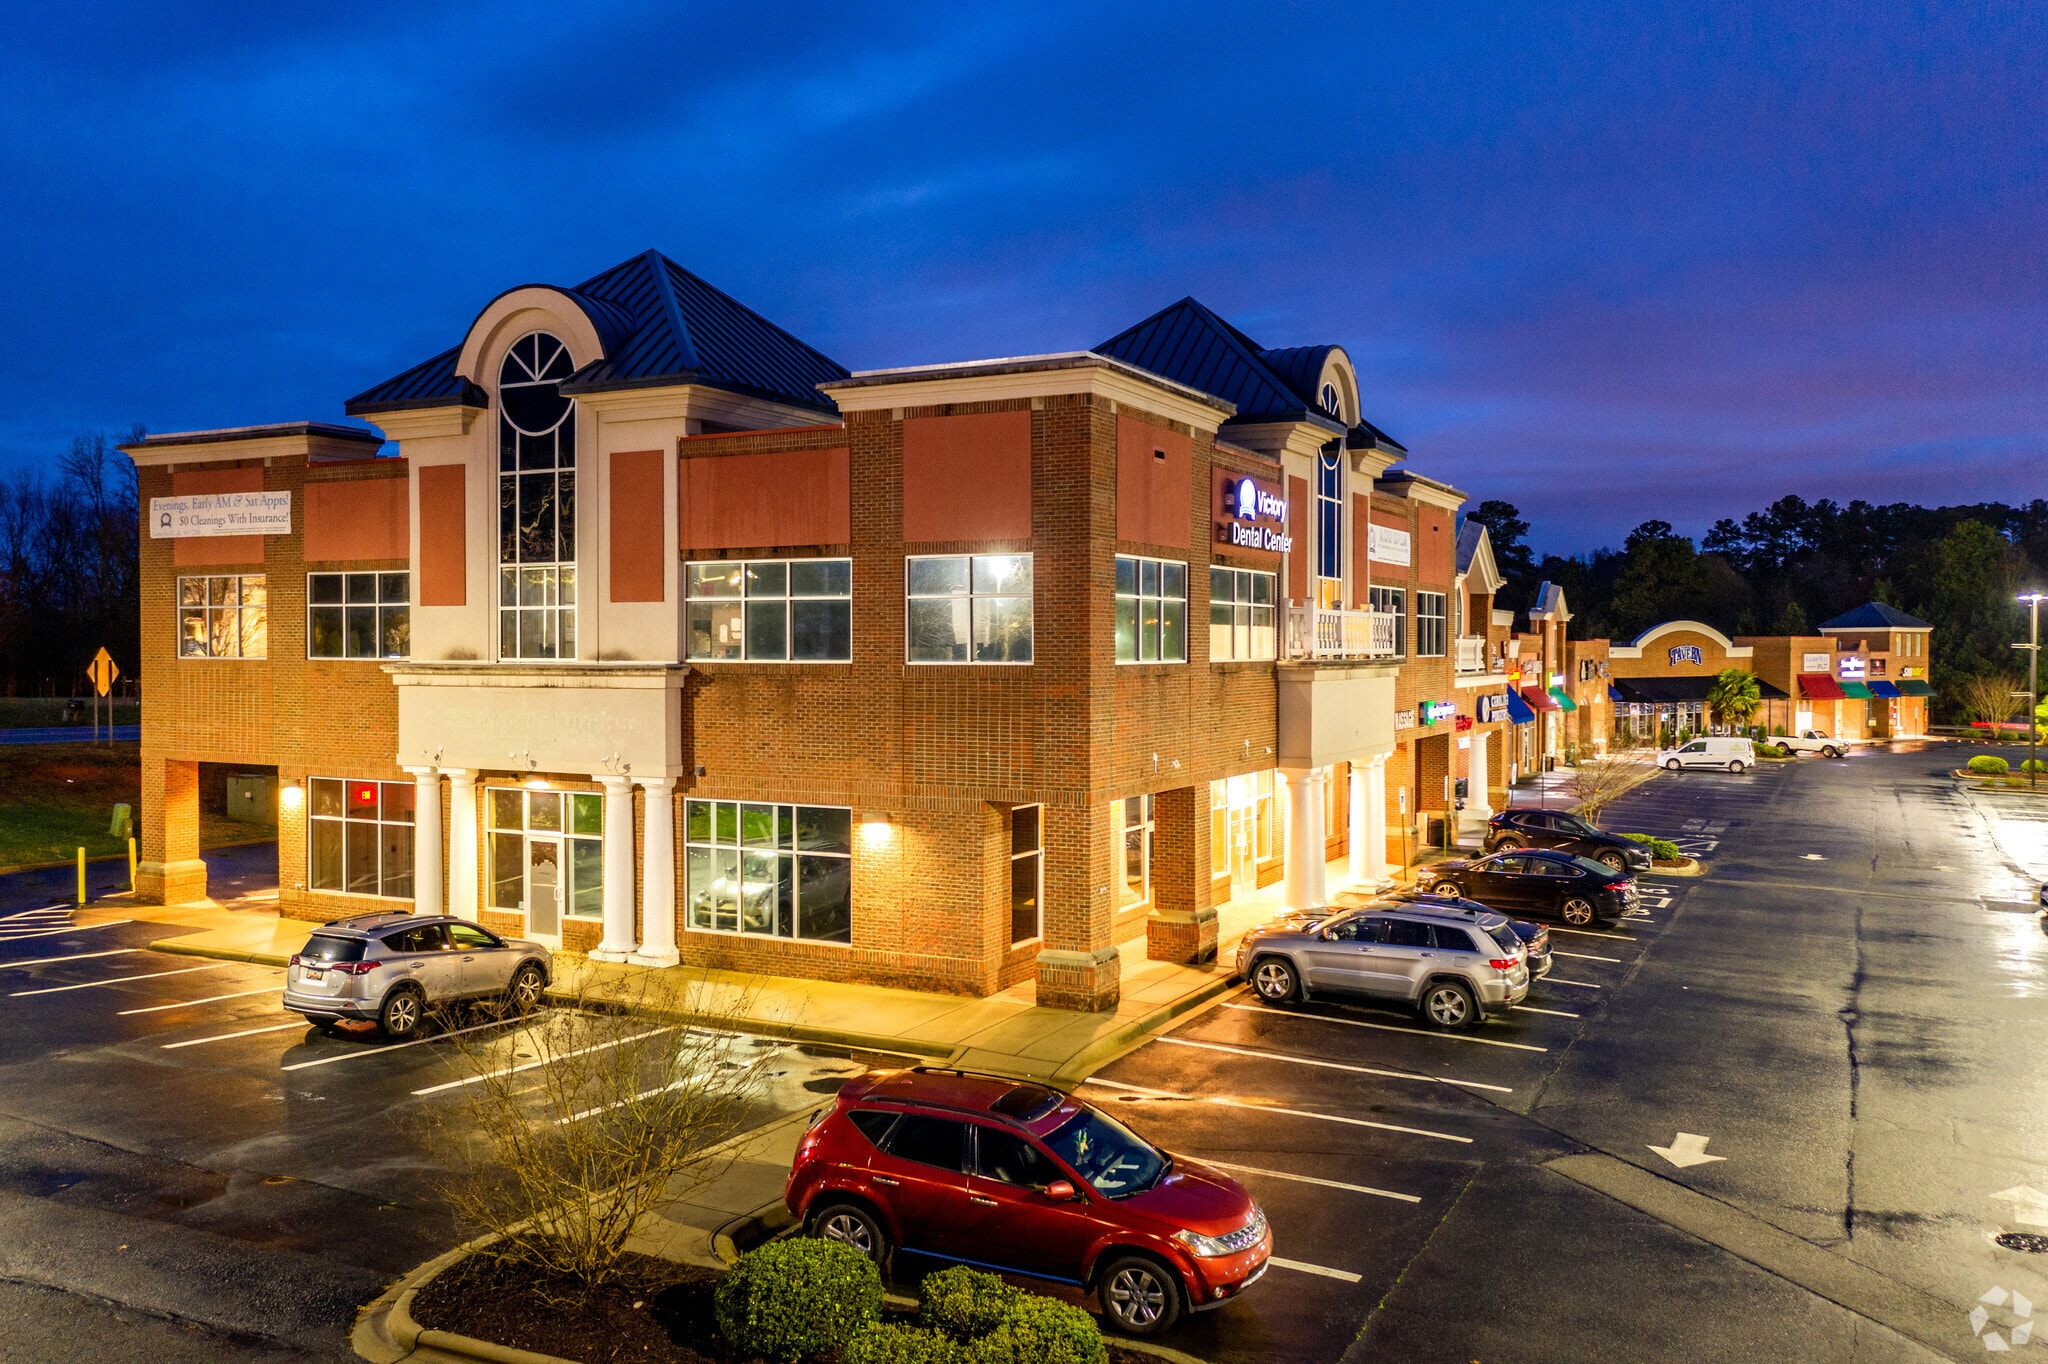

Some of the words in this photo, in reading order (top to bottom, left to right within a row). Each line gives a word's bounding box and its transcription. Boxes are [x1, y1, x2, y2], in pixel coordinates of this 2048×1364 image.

[192, 497, 213, 511] Early
[215, 496, 231, 508] AM
[233, 495, 244, 507] &
[245, 495, 258, 507] Sat
[260, 494, 289, 510] Appts!
[1257, 490, 1287, 523] Victory
[190, 514, 226, 527] Cleanings
[228, 513, 247, 524] With
[249, 512, 289, 524] Insurance!
[1232, 521, 1262, 549] Dental
[1264, 528, 1293, 553] Center
[1671, 646, 1703, 666] TAVERN
